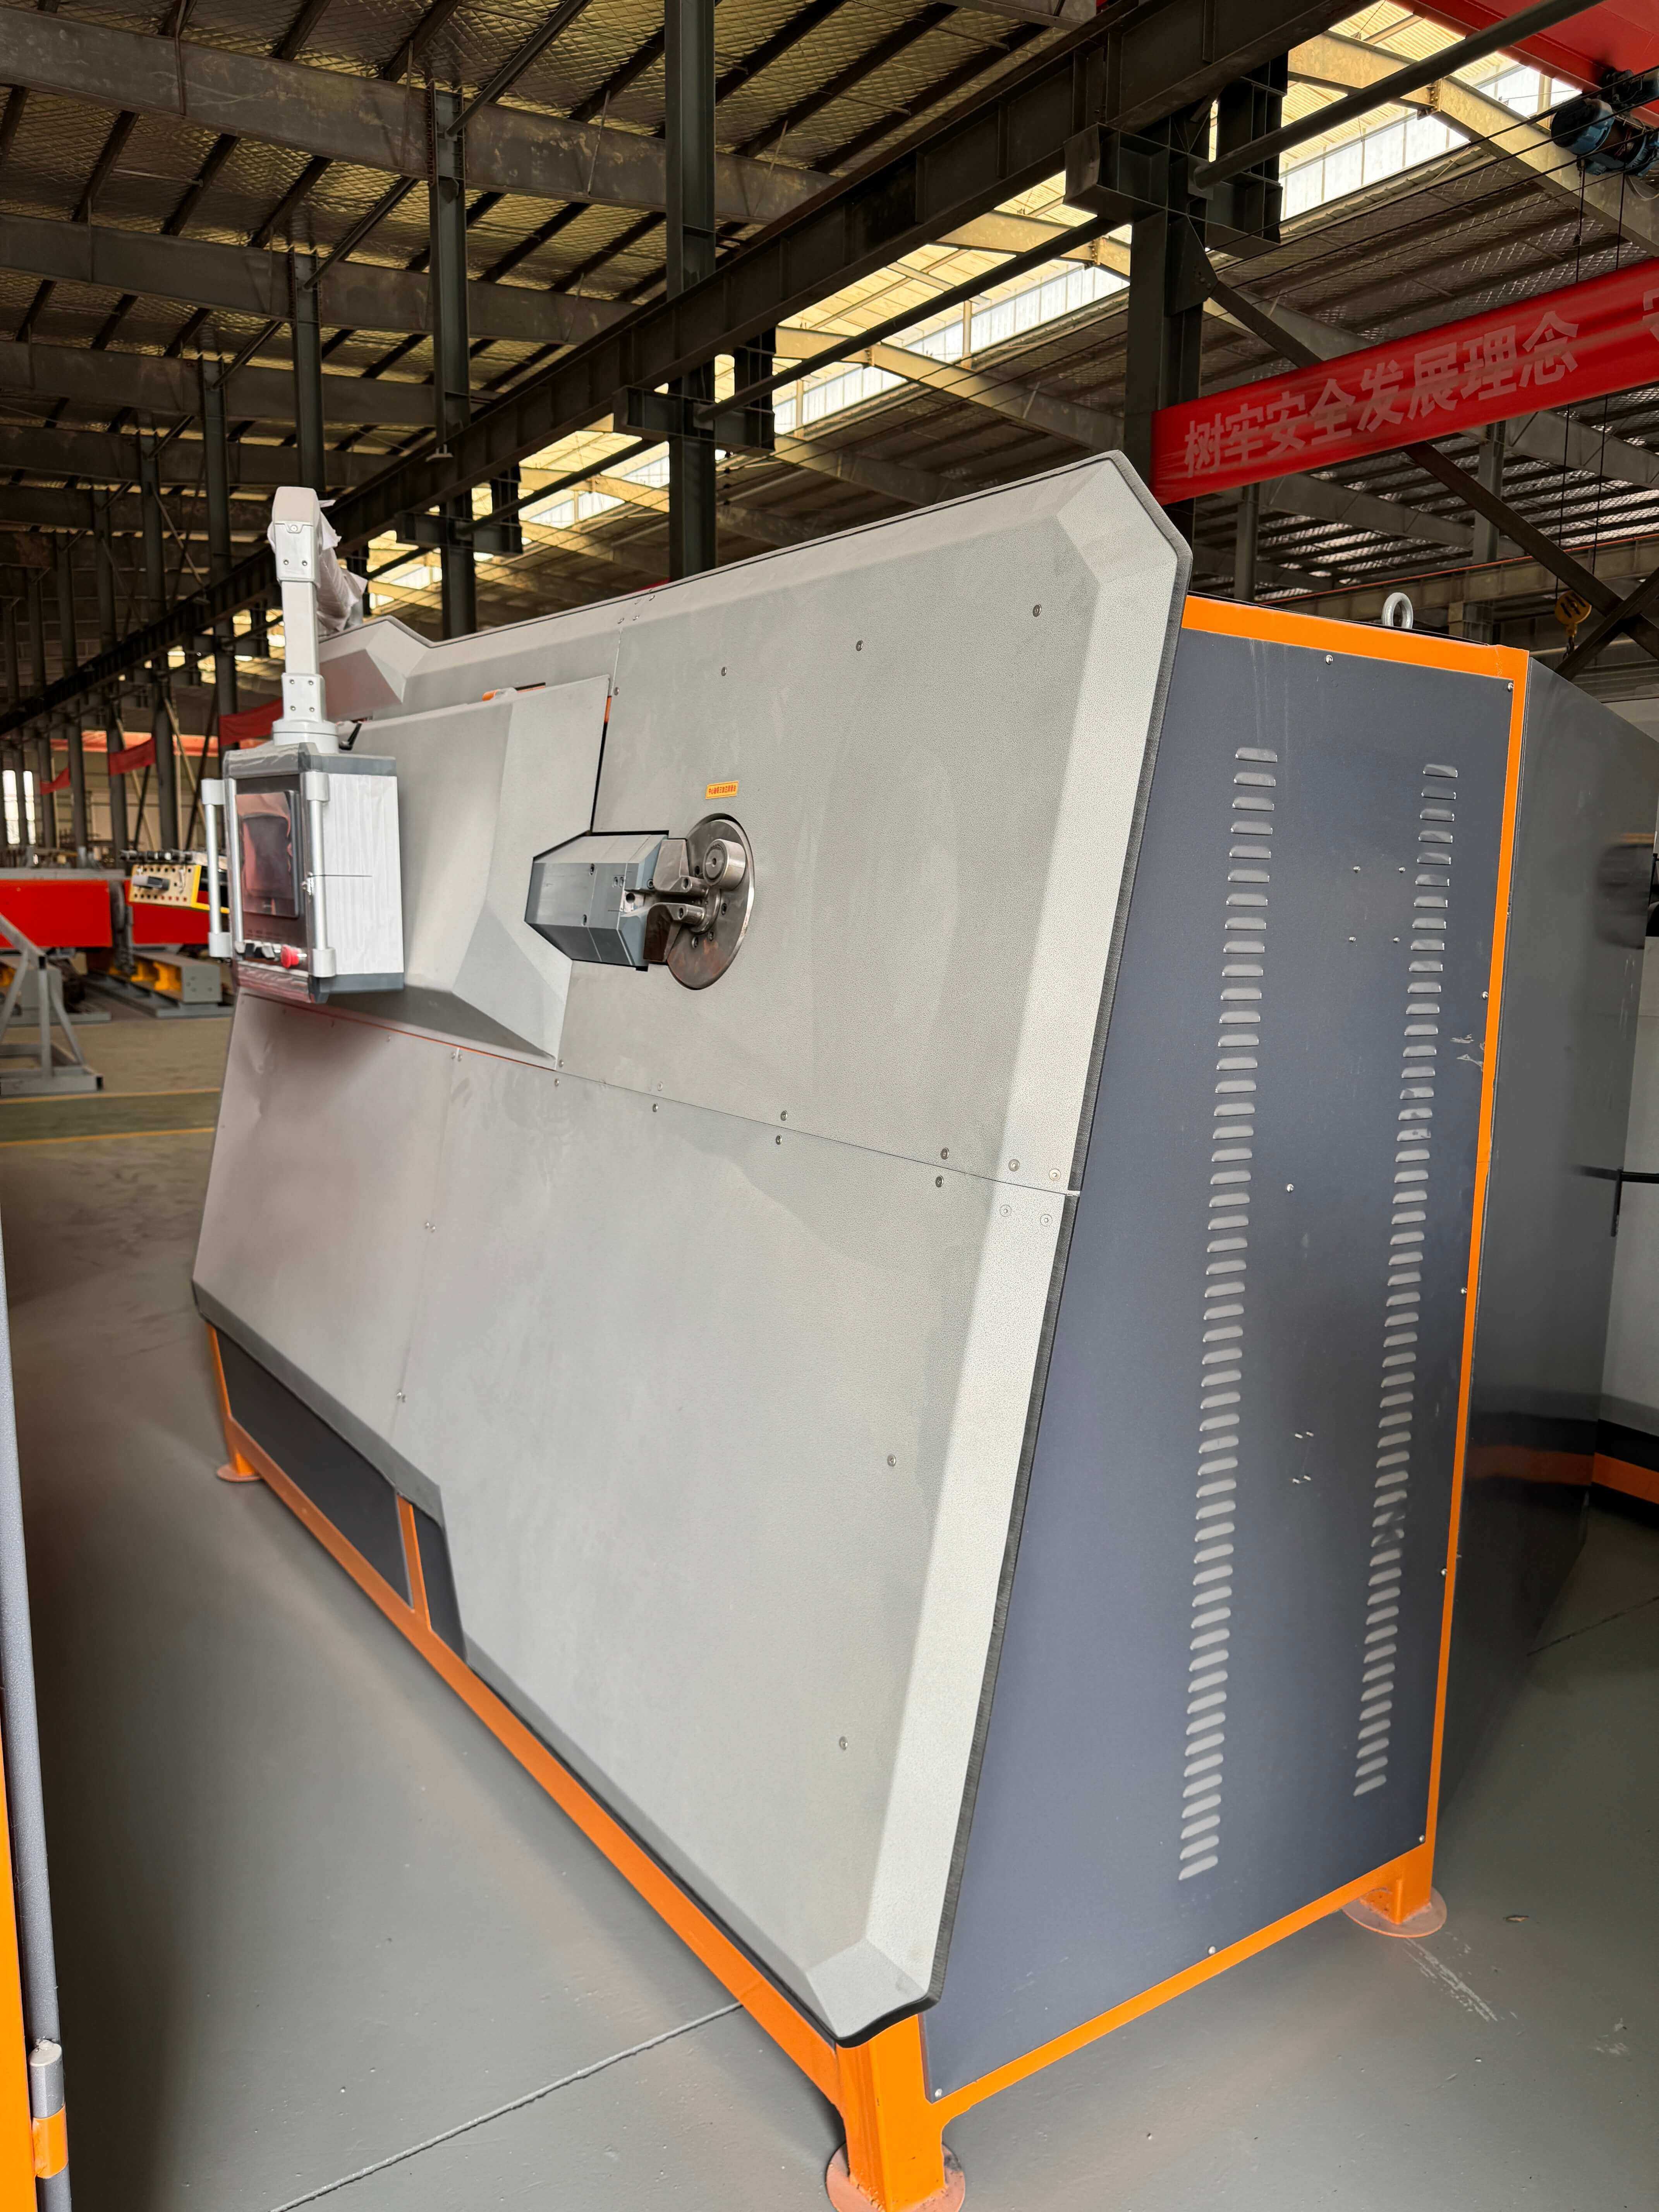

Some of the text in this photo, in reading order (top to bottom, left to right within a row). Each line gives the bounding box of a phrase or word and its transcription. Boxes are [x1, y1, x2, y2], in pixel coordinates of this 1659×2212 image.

[1184, 311, 1579, 478] 树牢安全发展理念
